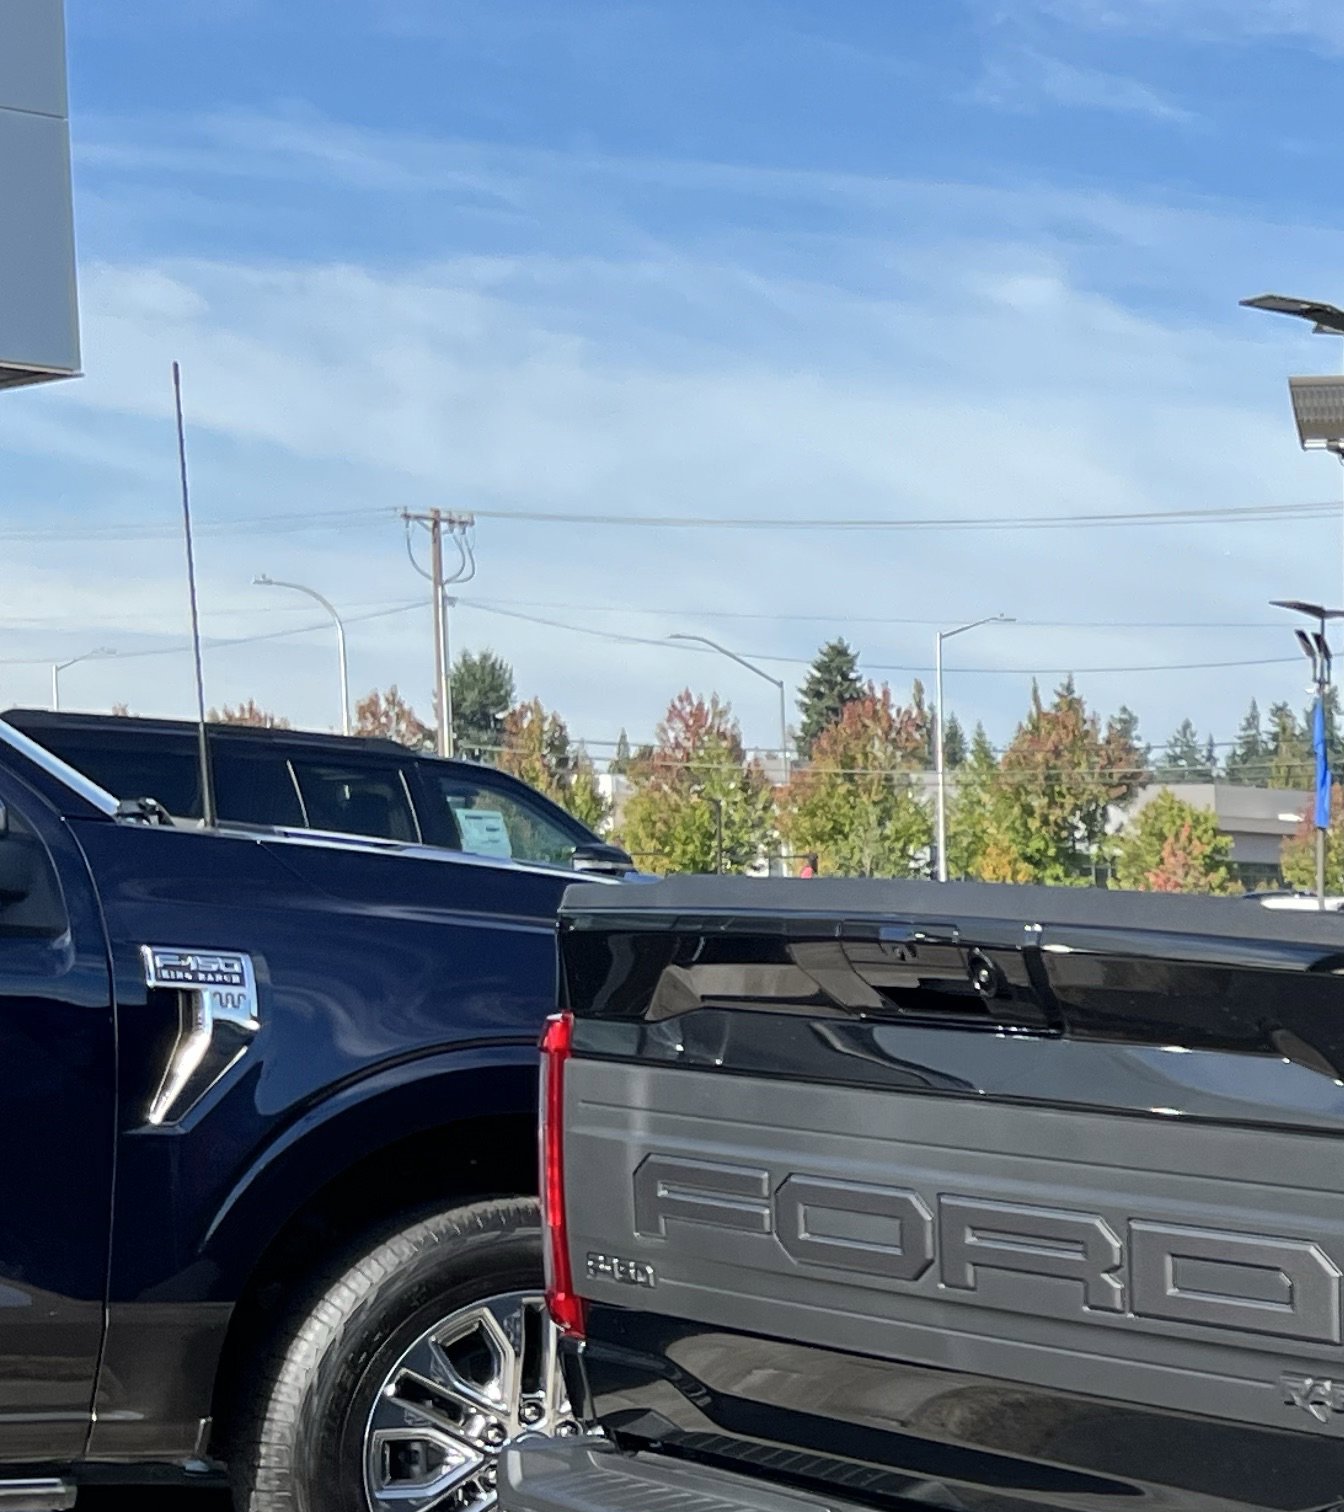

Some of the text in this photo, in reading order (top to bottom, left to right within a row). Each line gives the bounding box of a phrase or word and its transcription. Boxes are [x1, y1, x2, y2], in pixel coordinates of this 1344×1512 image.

[155, 954, 242, 973] F-150
[161, 969, 241, 984] KING RANCH
[632, 1152, 1344, 1346] FORD
